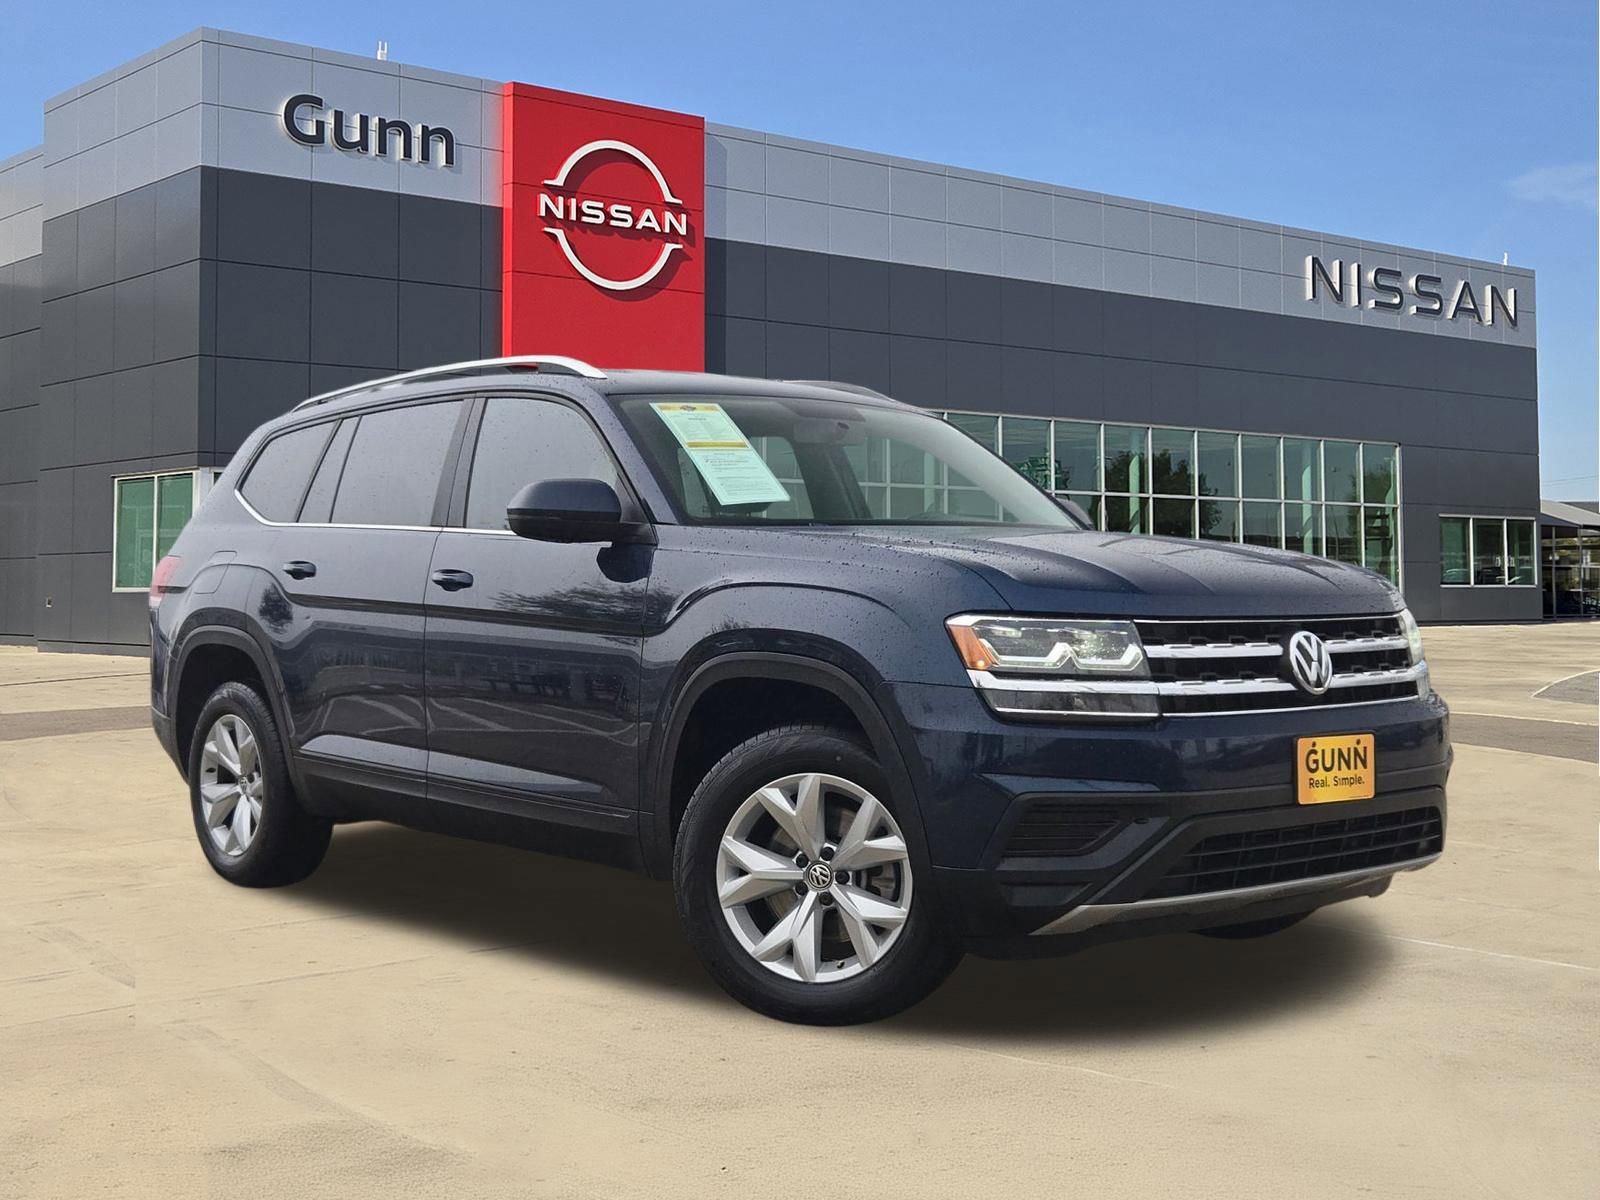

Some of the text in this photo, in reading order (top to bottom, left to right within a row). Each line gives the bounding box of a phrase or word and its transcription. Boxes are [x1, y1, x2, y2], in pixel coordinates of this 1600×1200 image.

[281, 93, 456, 168] Gunn
[538, 193, 688, 236] NISSAN
[1305, 255, 1518, 327] NISSAN
[1291, 632, 1332, 693] VW
[1305, 745, 1368, 774] GUNN
[1308, 775, 1365, 789] Real. Simple.
